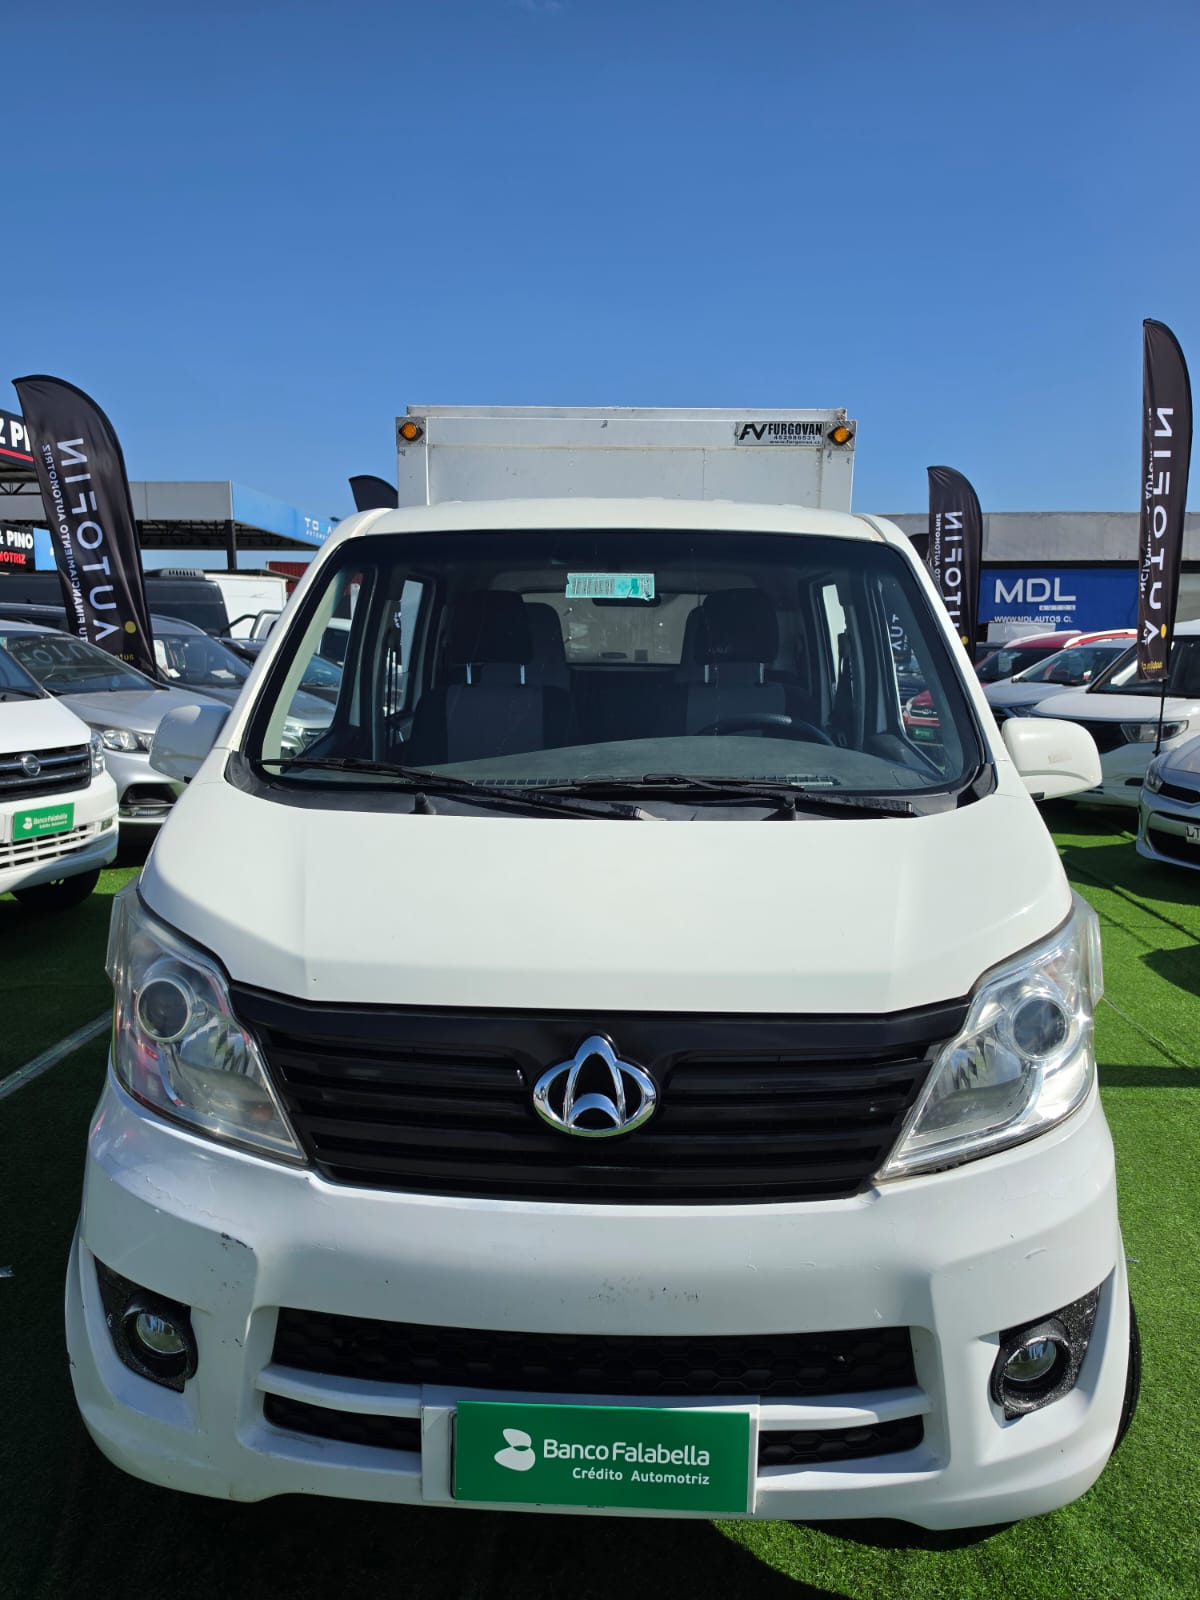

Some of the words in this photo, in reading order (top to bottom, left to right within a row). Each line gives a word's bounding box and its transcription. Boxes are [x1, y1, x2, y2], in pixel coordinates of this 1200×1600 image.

[768, 423, 823, 436] FURGOVAN
[6, 530, 34, 550] PINO
[995, 577, 1076, 603] MDL
[543, 1438, 609, 1461] Banco
[612, 1442, 710, 1466] Falabella
[572, 1467, 623, 1481] Crédito
[631, 1470, 710, 1485] Automotriz
